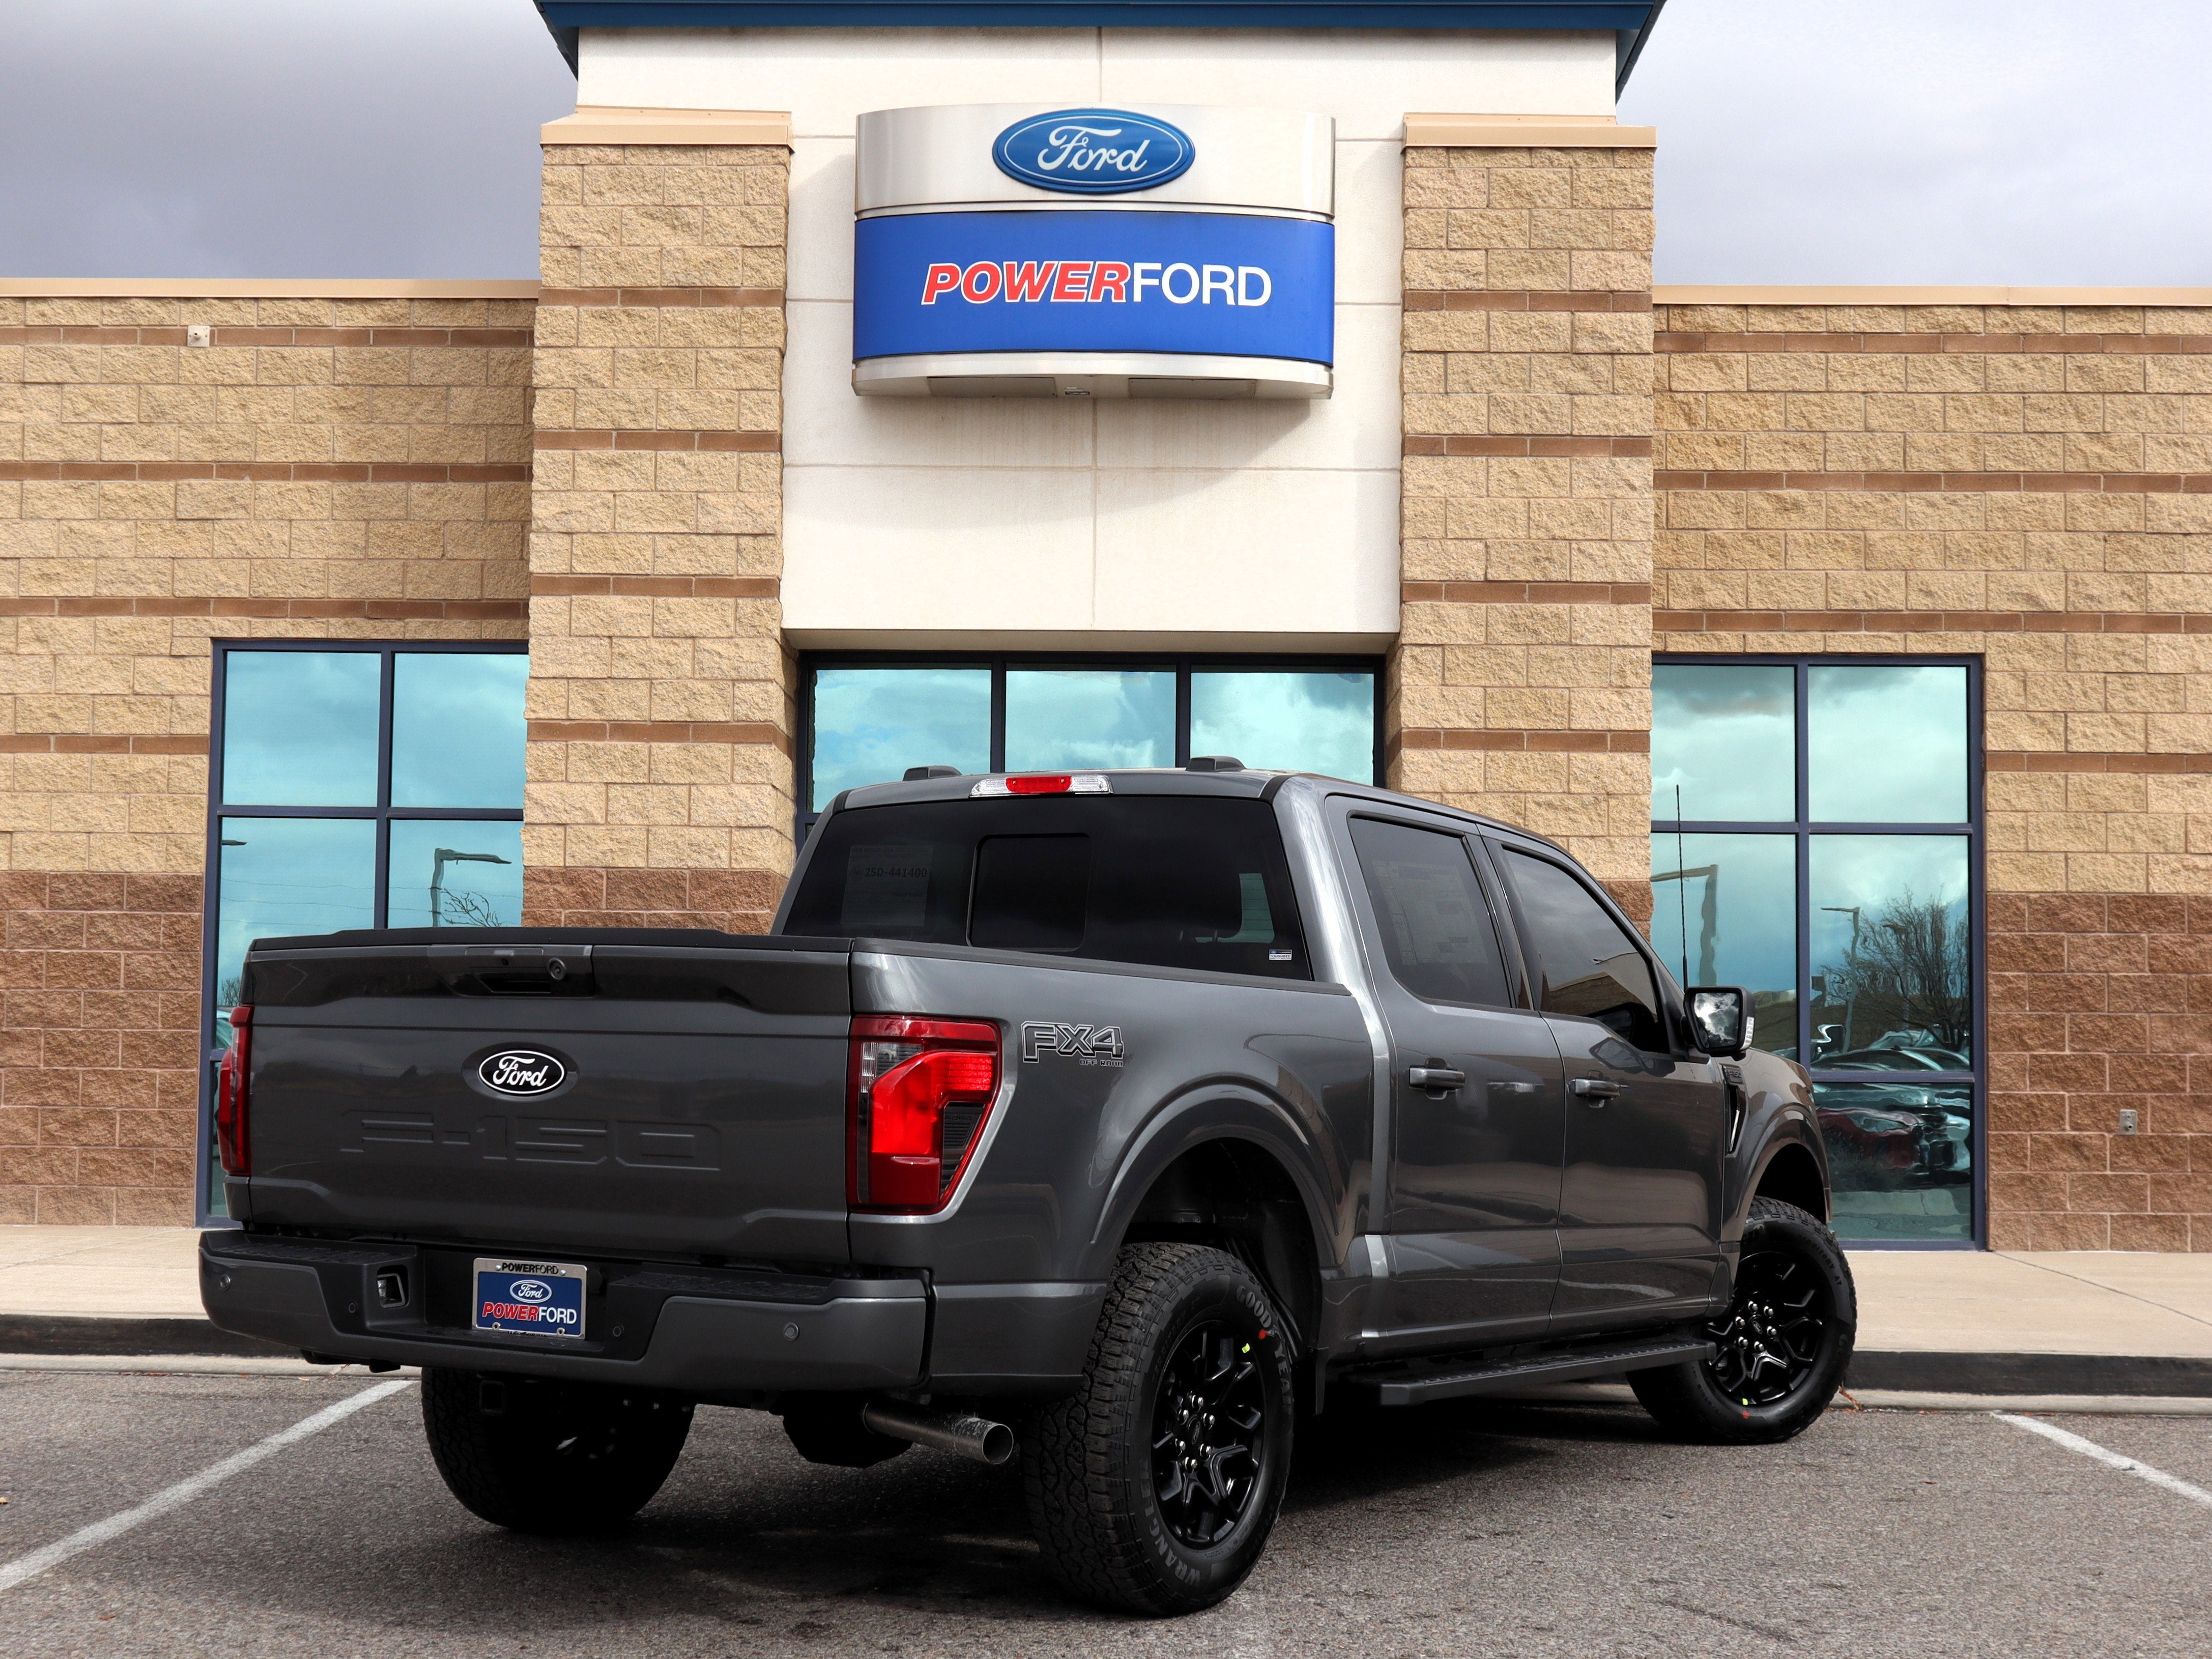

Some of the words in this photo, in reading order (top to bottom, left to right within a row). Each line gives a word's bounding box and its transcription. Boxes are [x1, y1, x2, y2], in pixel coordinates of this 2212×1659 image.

[1037, 125, 1151, 173] Ford
[1021, 1021, 1124, 1063] FX4
[492, 1055, 549, 1088] Ford
[340, 1109, 721, 1171] F-150
[502, 1263, 559, 1275] POWERFORD
[518, 1283, 543, 1298] Ford
[482, 1302, 577, 1325] POWERFORD
